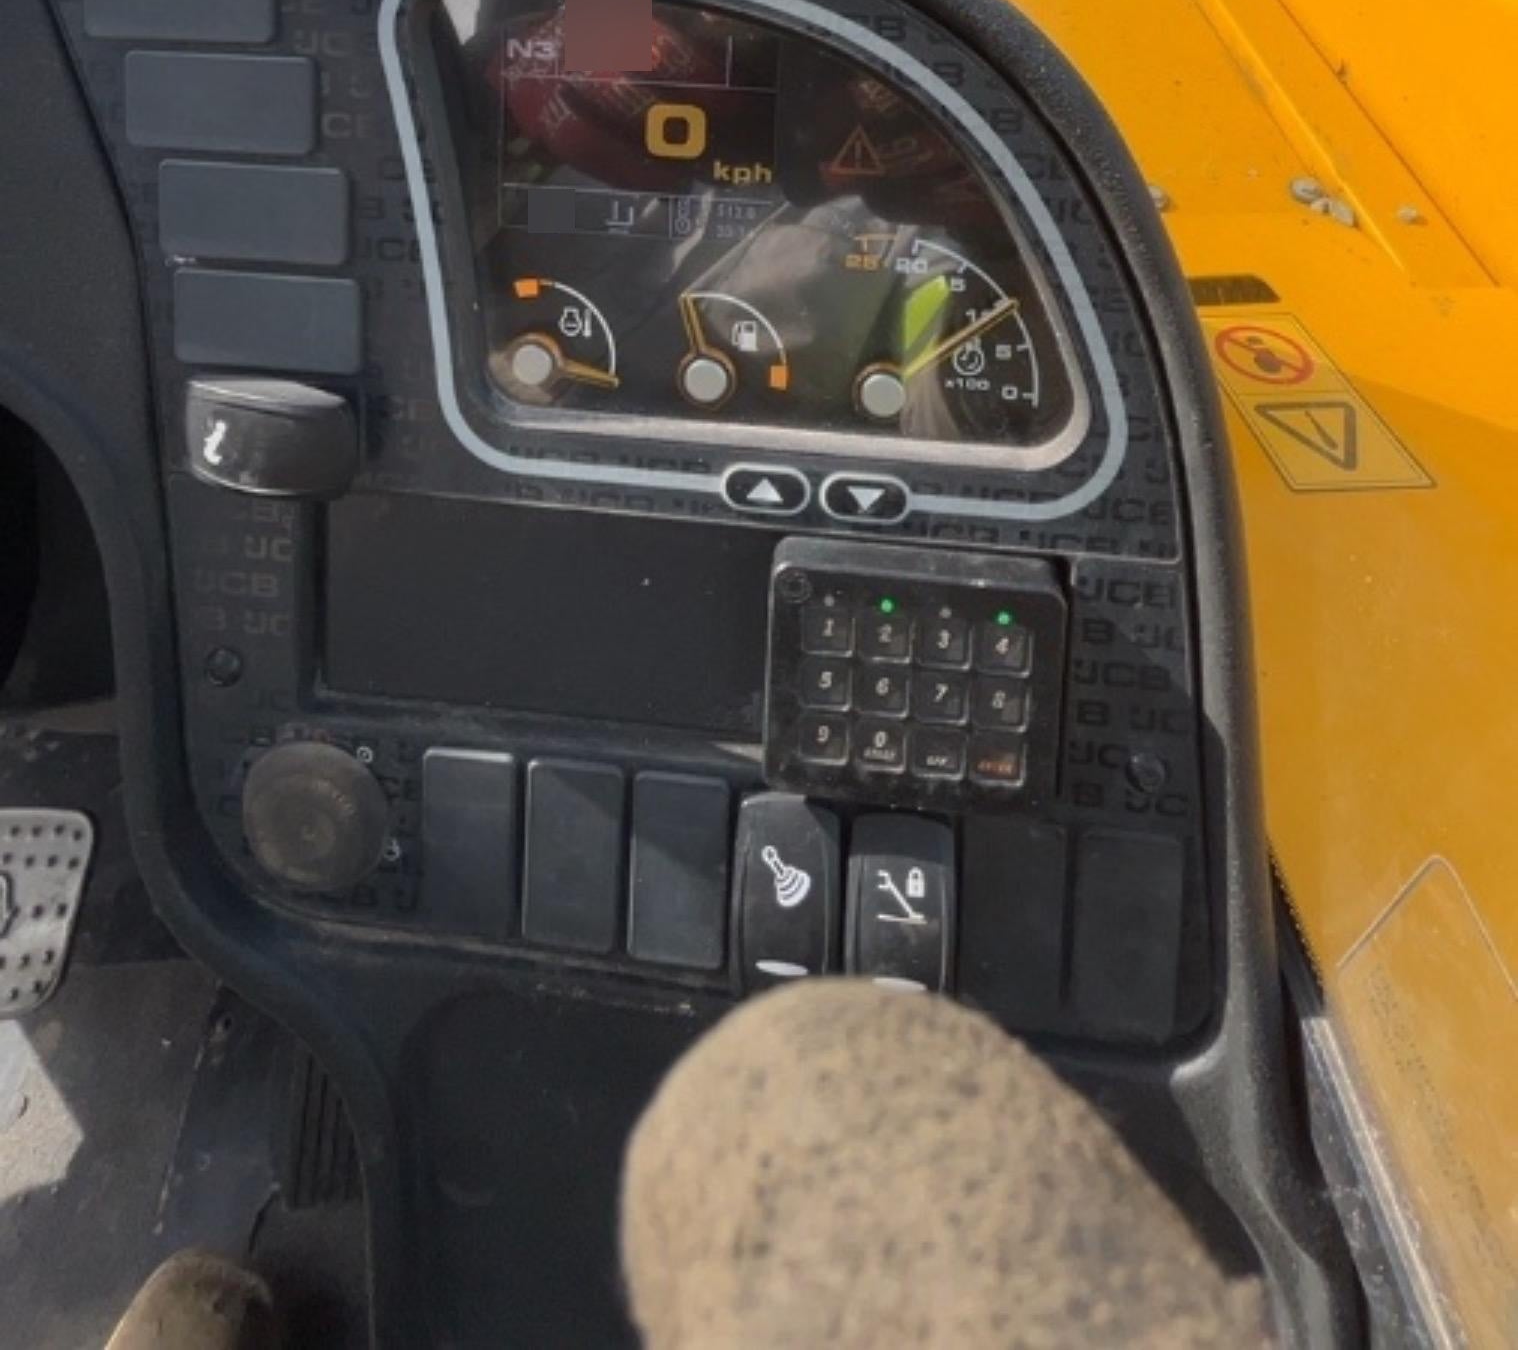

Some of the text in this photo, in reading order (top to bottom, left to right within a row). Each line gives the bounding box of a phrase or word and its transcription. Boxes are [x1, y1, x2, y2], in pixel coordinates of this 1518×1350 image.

[644, 102, 709, 160] 0
[712, 158, 773, 185] kph
[821, 616, 1010, 656] 1 2 3 4
[818, 670, 1007, 710] 5 6 7 8
[815, 724, 889, 748] 9 0
